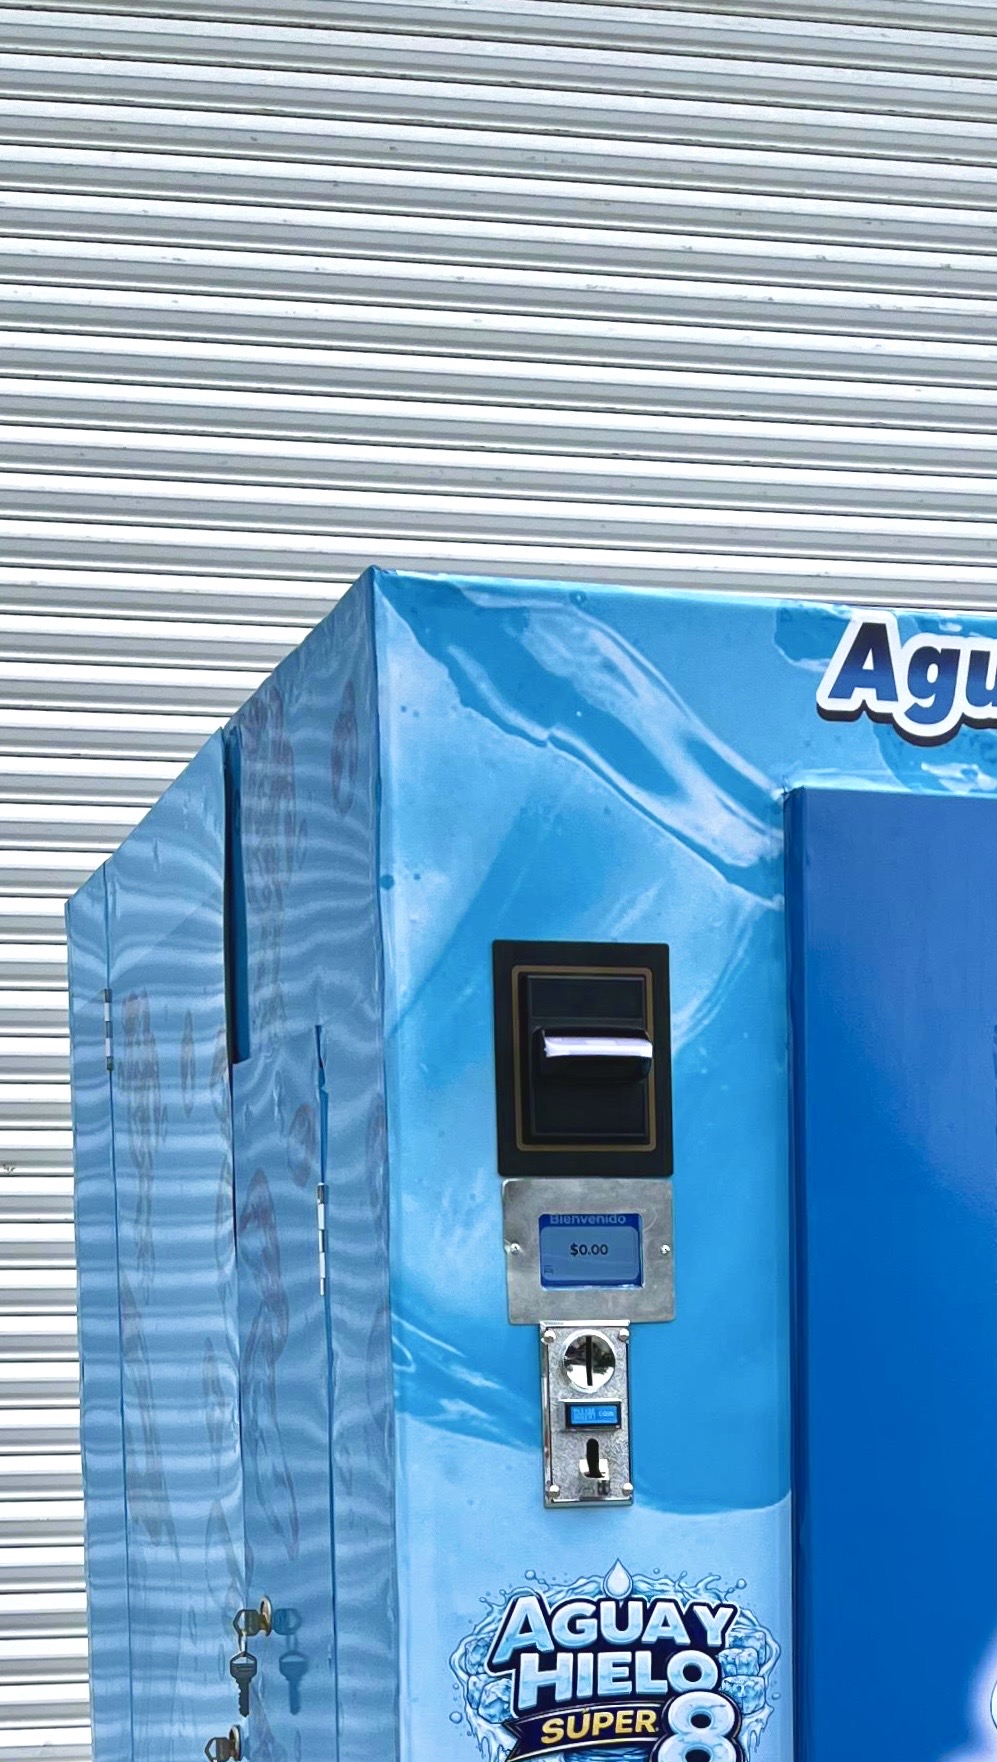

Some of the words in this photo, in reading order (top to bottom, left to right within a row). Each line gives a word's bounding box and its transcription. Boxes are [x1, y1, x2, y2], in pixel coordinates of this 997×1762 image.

[569, 1242, 608, 1257] $0.00
[492, 1594, 691, 1665] AGUA
[691, 1603, 734, 1648] Y
[517, 1649, 720, 1711] HIELO
